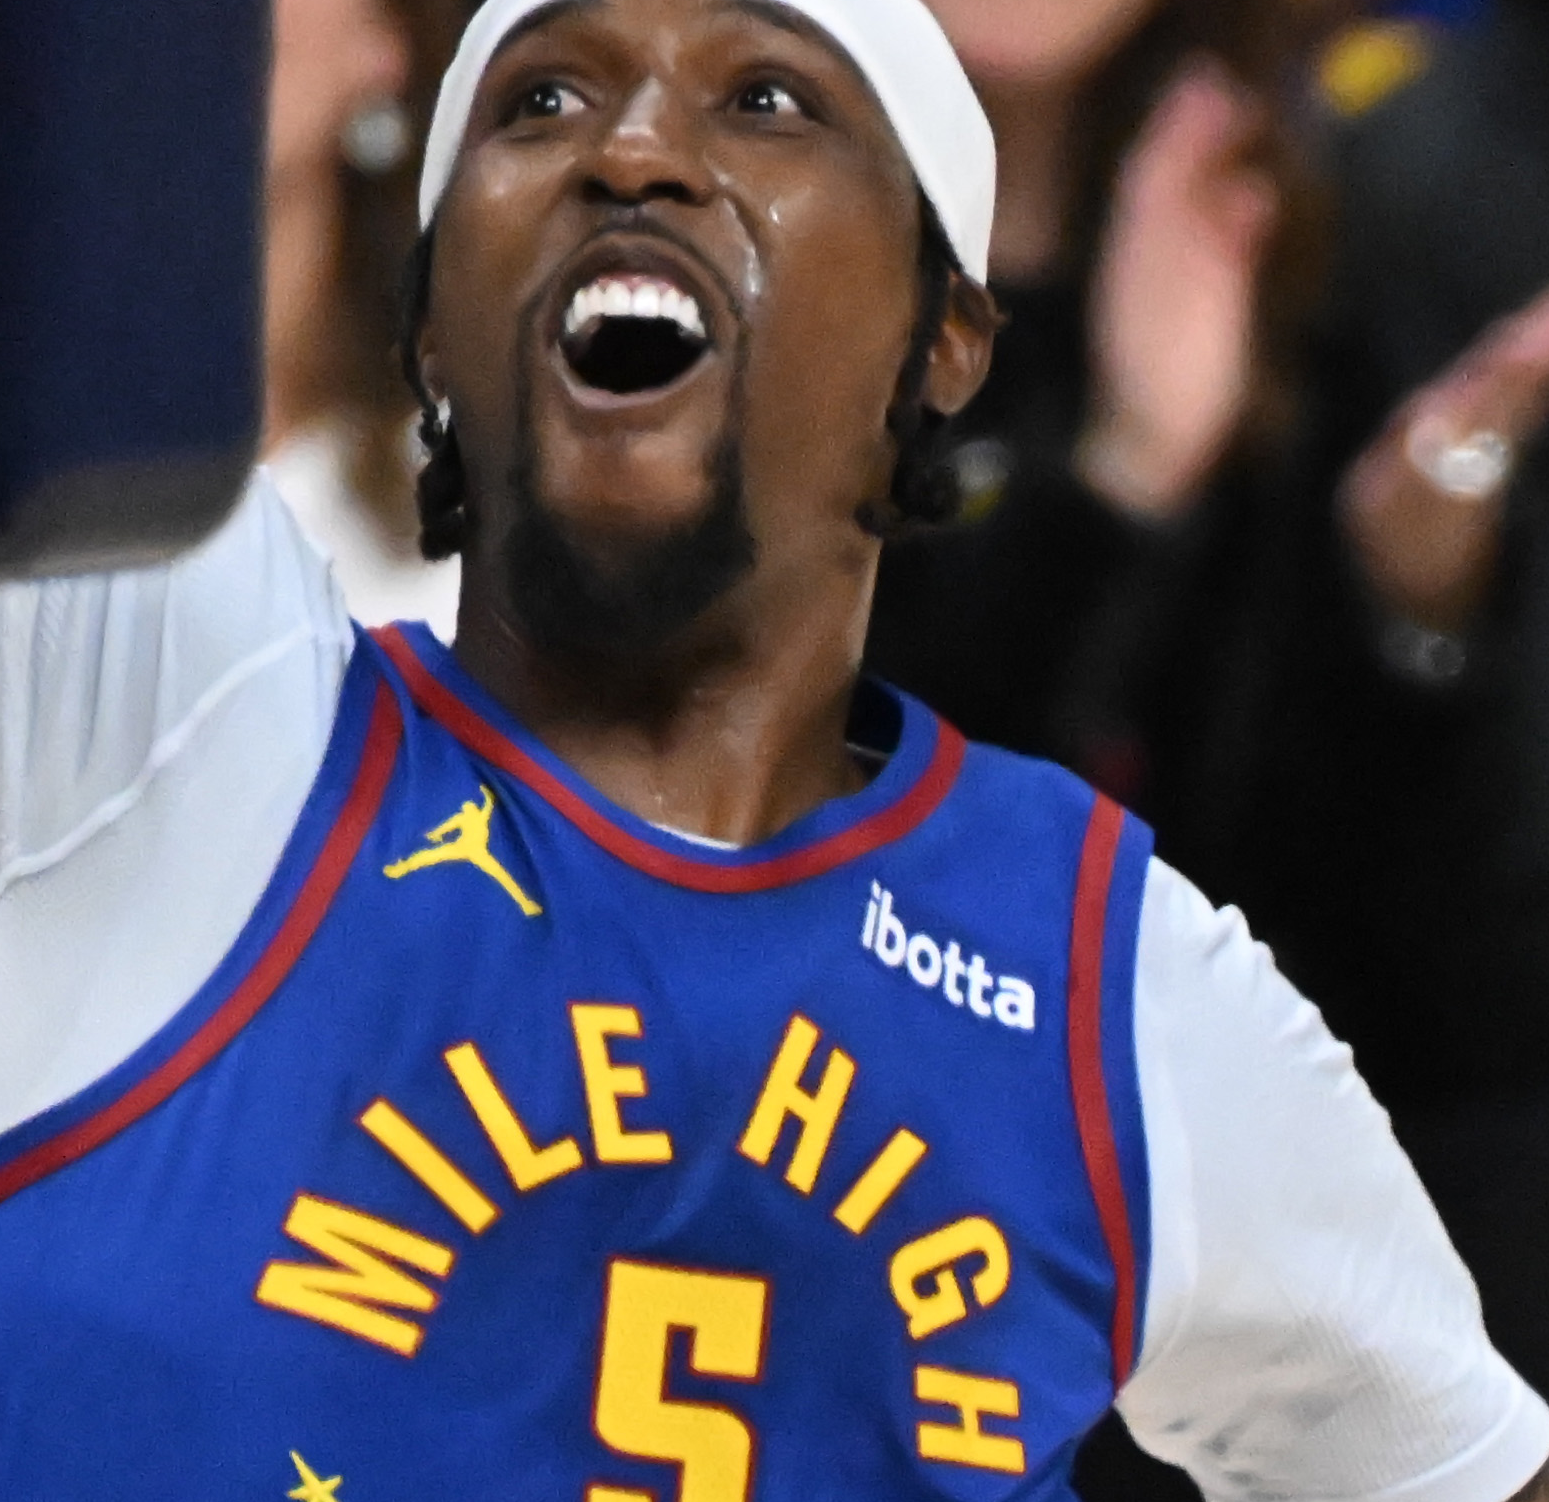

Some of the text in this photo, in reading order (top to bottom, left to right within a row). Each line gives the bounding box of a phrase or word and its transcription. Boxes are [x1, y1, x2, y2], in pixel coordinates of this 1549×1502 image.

[862, 878, 1036, 1032] ibotta
[254, 1001, 1028, 1476] MILE HIGH
